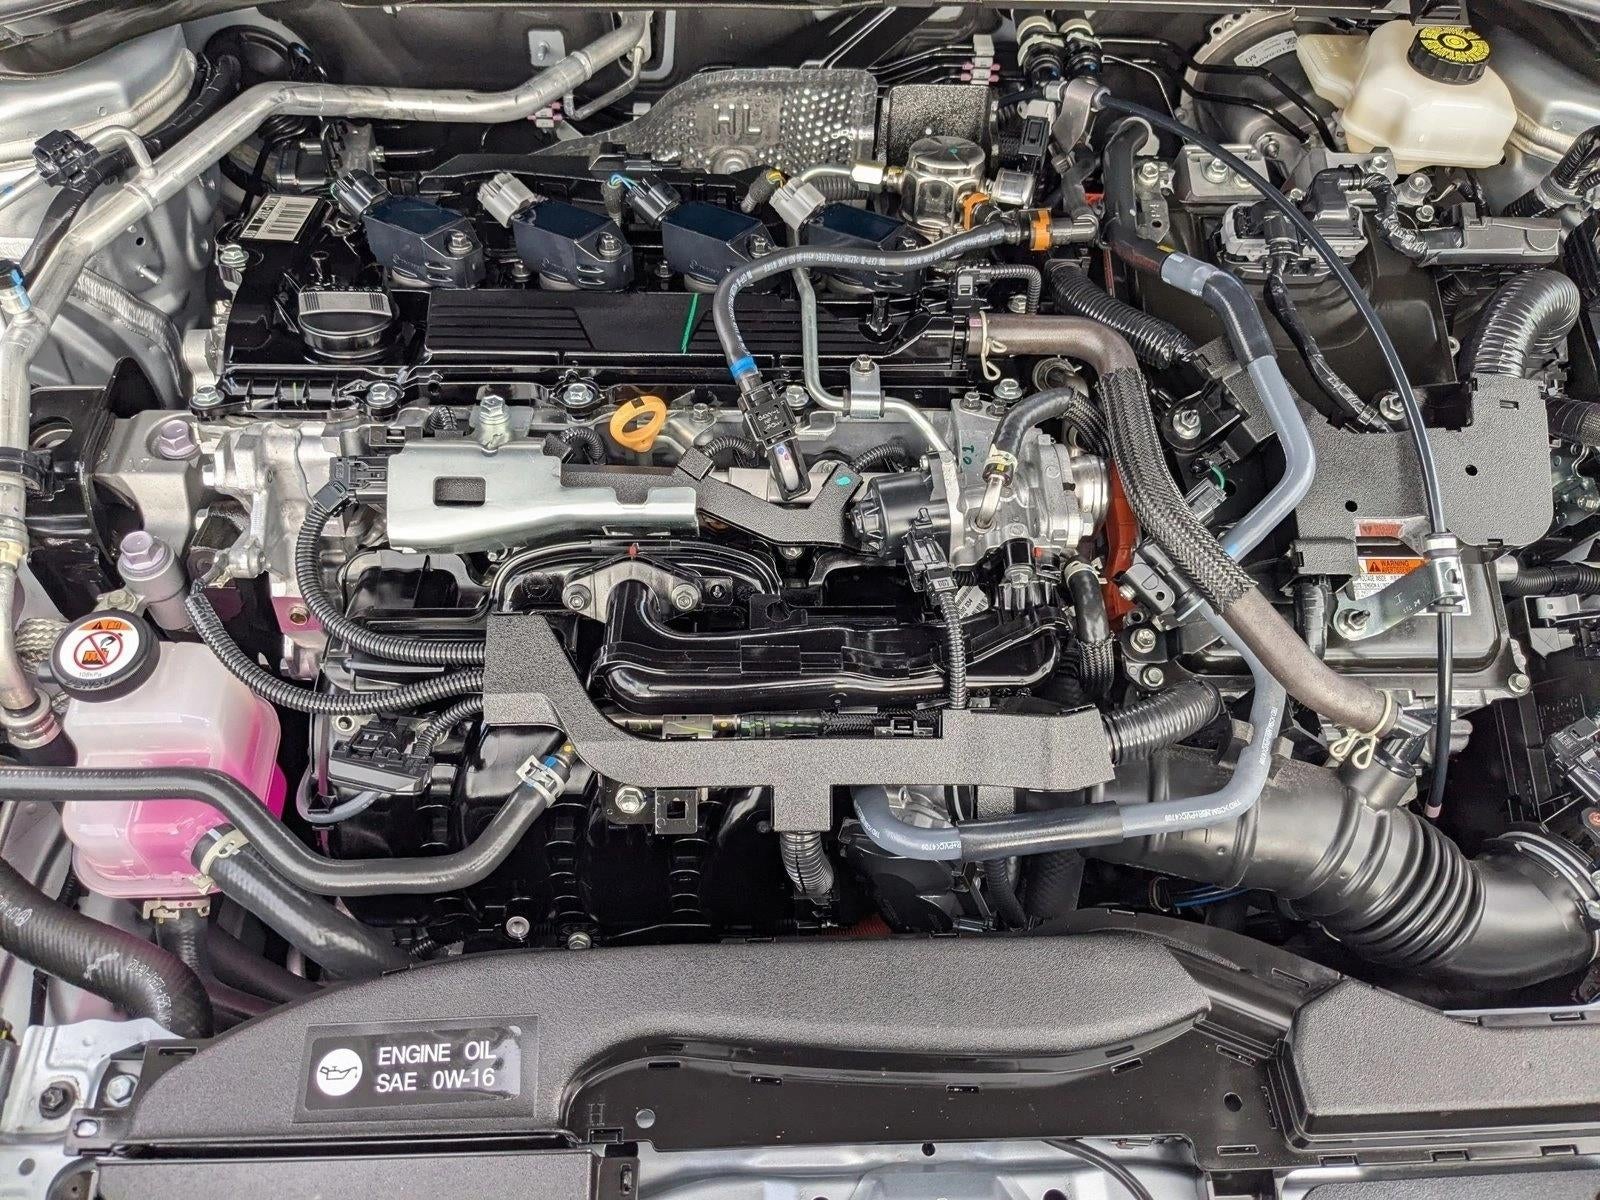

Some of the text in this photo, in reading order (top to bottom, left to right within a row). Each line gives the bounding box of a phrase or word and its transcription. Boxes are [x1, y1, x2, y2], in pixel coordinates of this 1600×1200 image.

[377, 1040, 497, 1066] ENGINE OIL
[376, 1067, 496, 1093] SAE 0W-16
